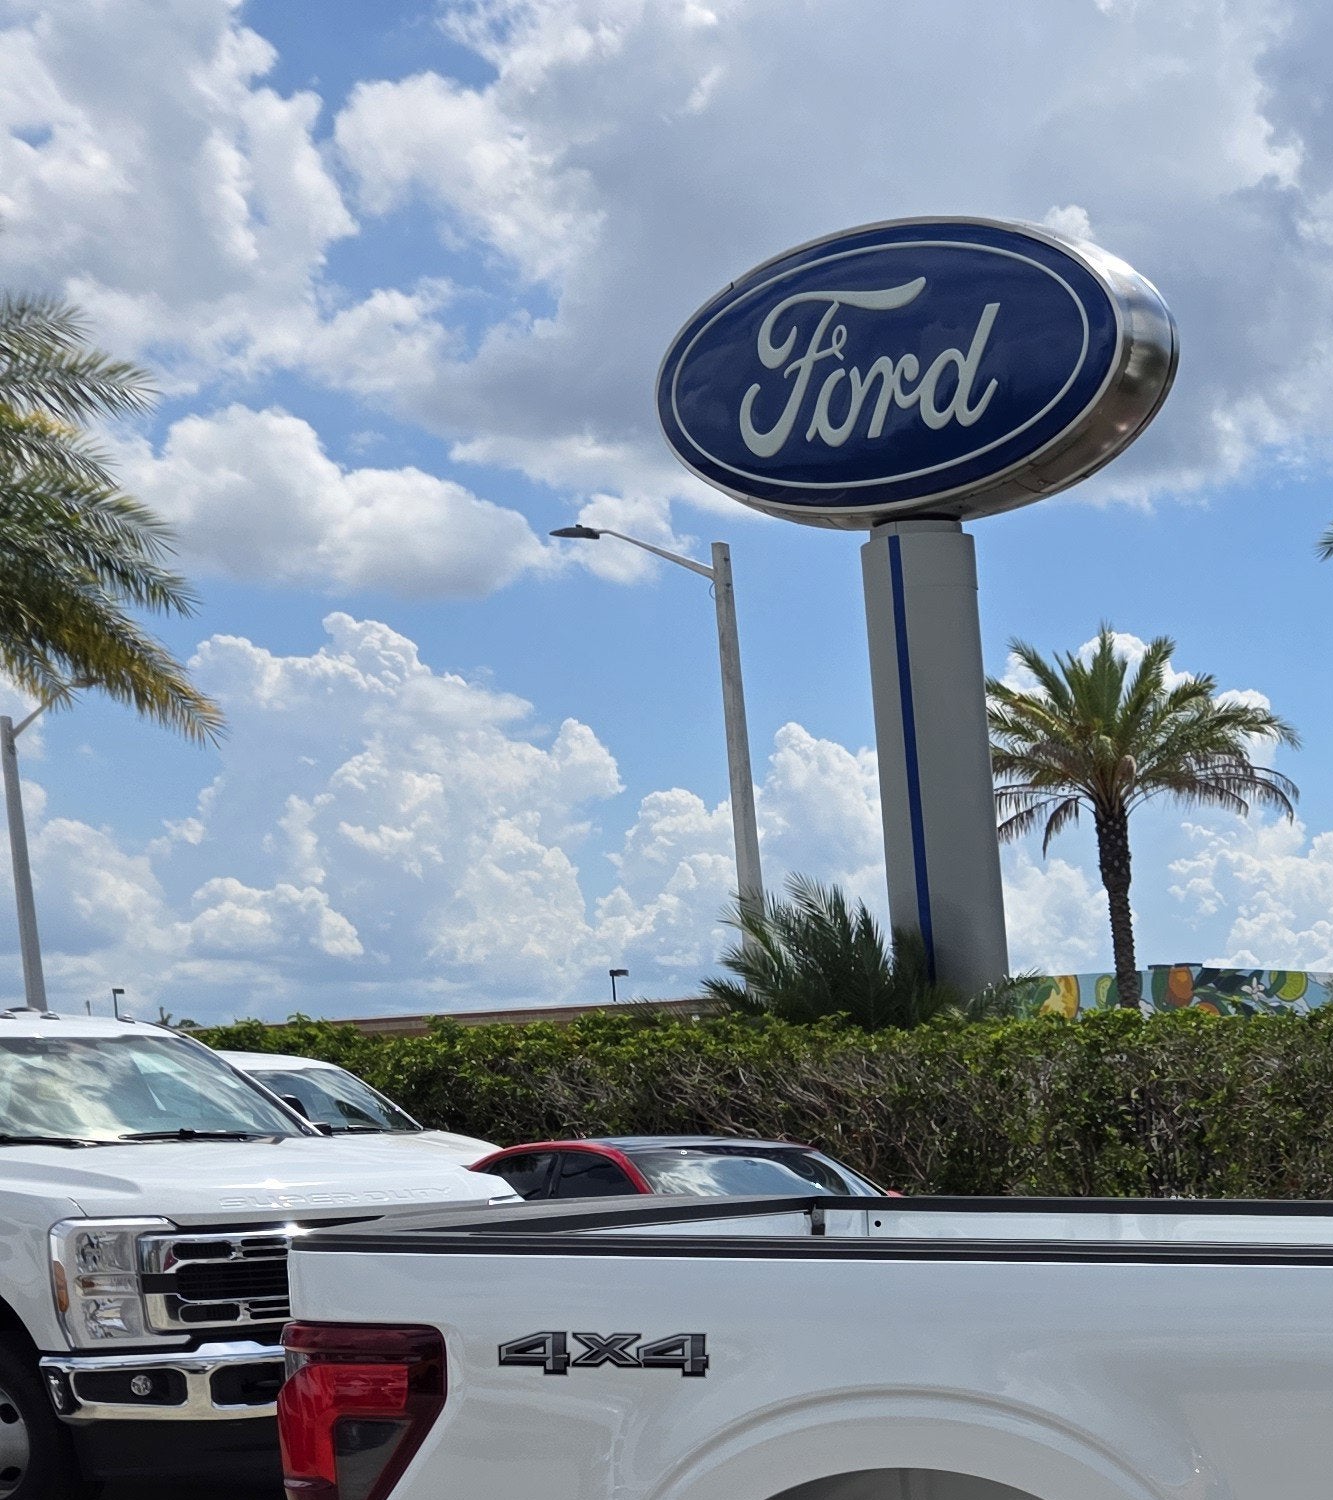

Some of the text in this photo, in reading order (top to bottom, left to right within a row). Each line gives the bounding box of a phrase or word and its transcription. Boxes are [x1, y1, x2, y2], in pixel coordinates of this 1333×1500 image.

[738, 276, 1000, 458] Ford
[219, 1187, 450, 1209] SUPER DUTY
